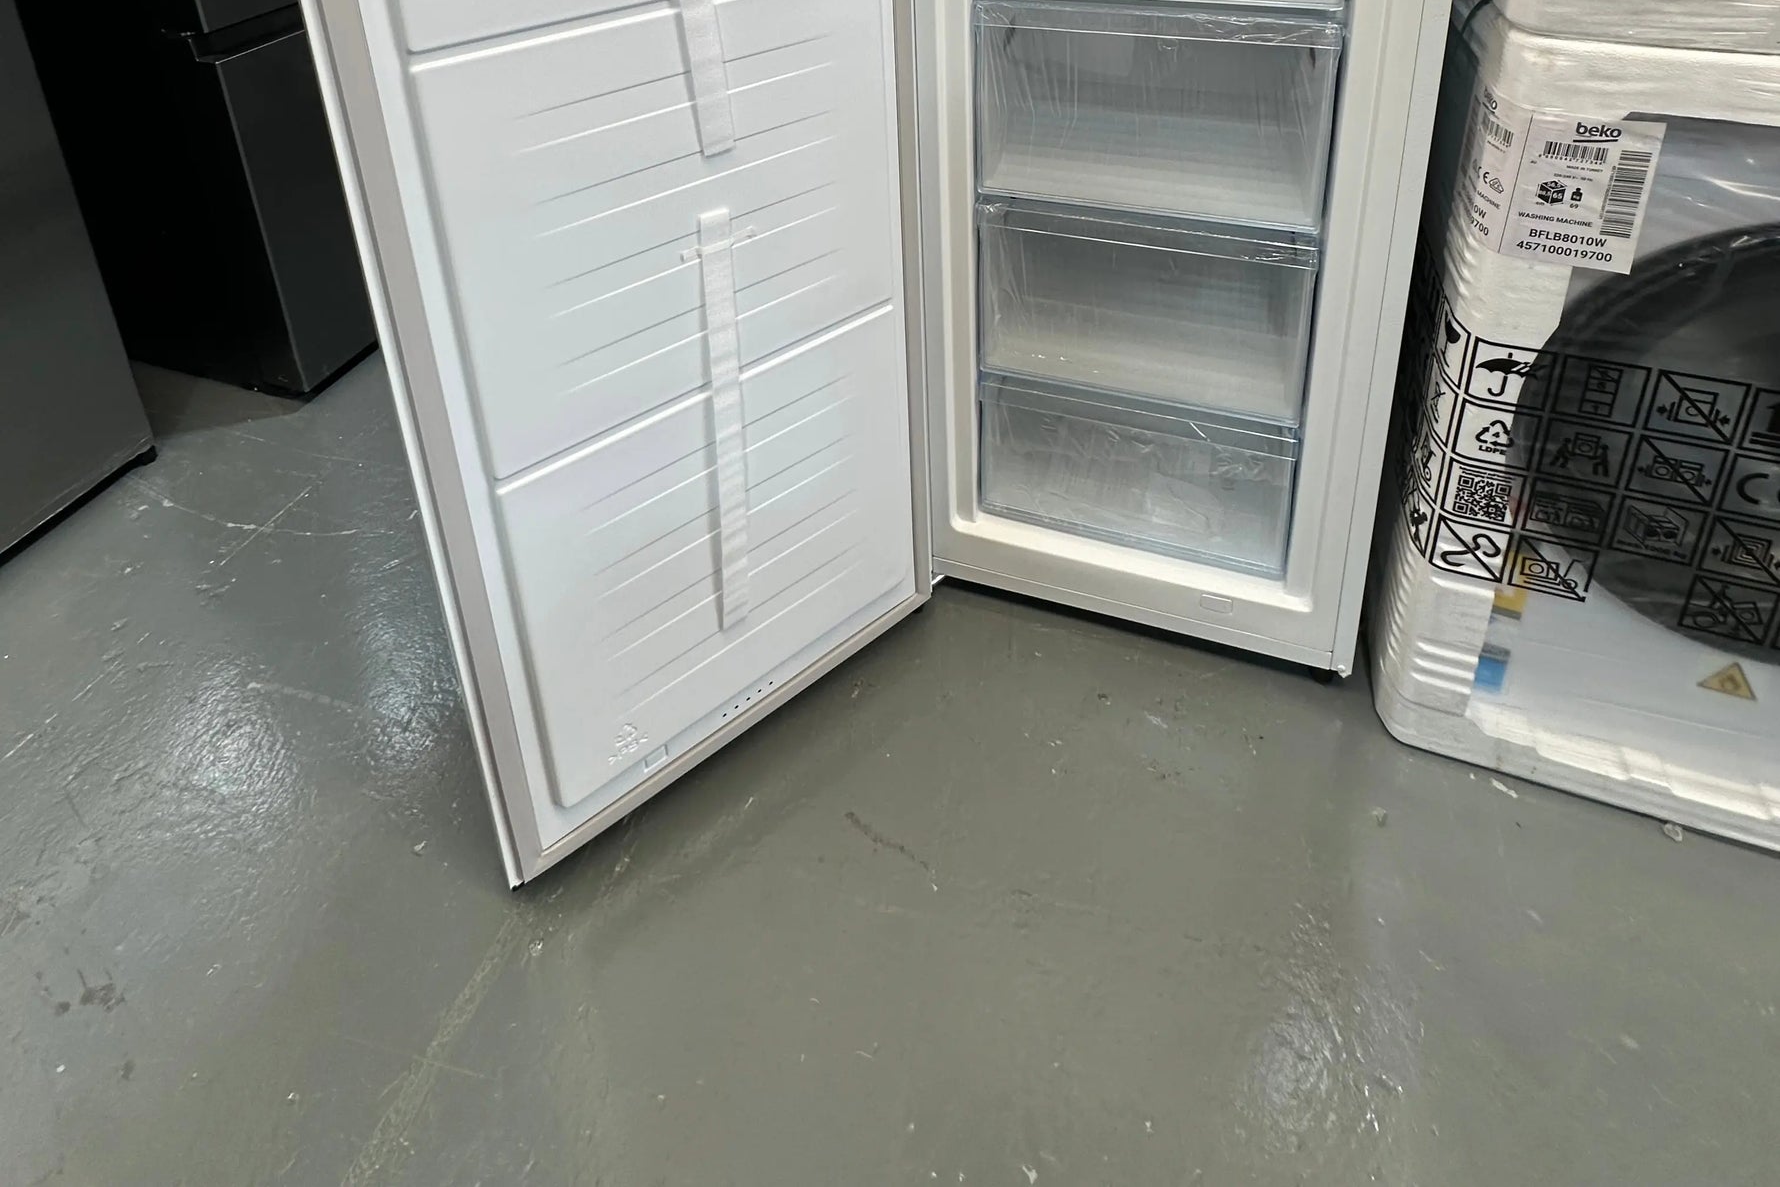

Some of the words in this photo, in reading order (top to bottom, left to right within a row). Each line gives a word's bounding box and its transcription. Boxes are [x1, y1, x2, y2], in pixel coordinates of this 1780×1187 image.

[1575, 121, 1622, 138] beko
[1518, 210, 1555, 222] WASHING
[1555, 217, 1593, 228] MACHINE
[1528, 228, 1607, 247] BFLB8010W
[1516, 240, 1613, 262] 457100019700
[1479, 445, 1507, 456] LDPE
